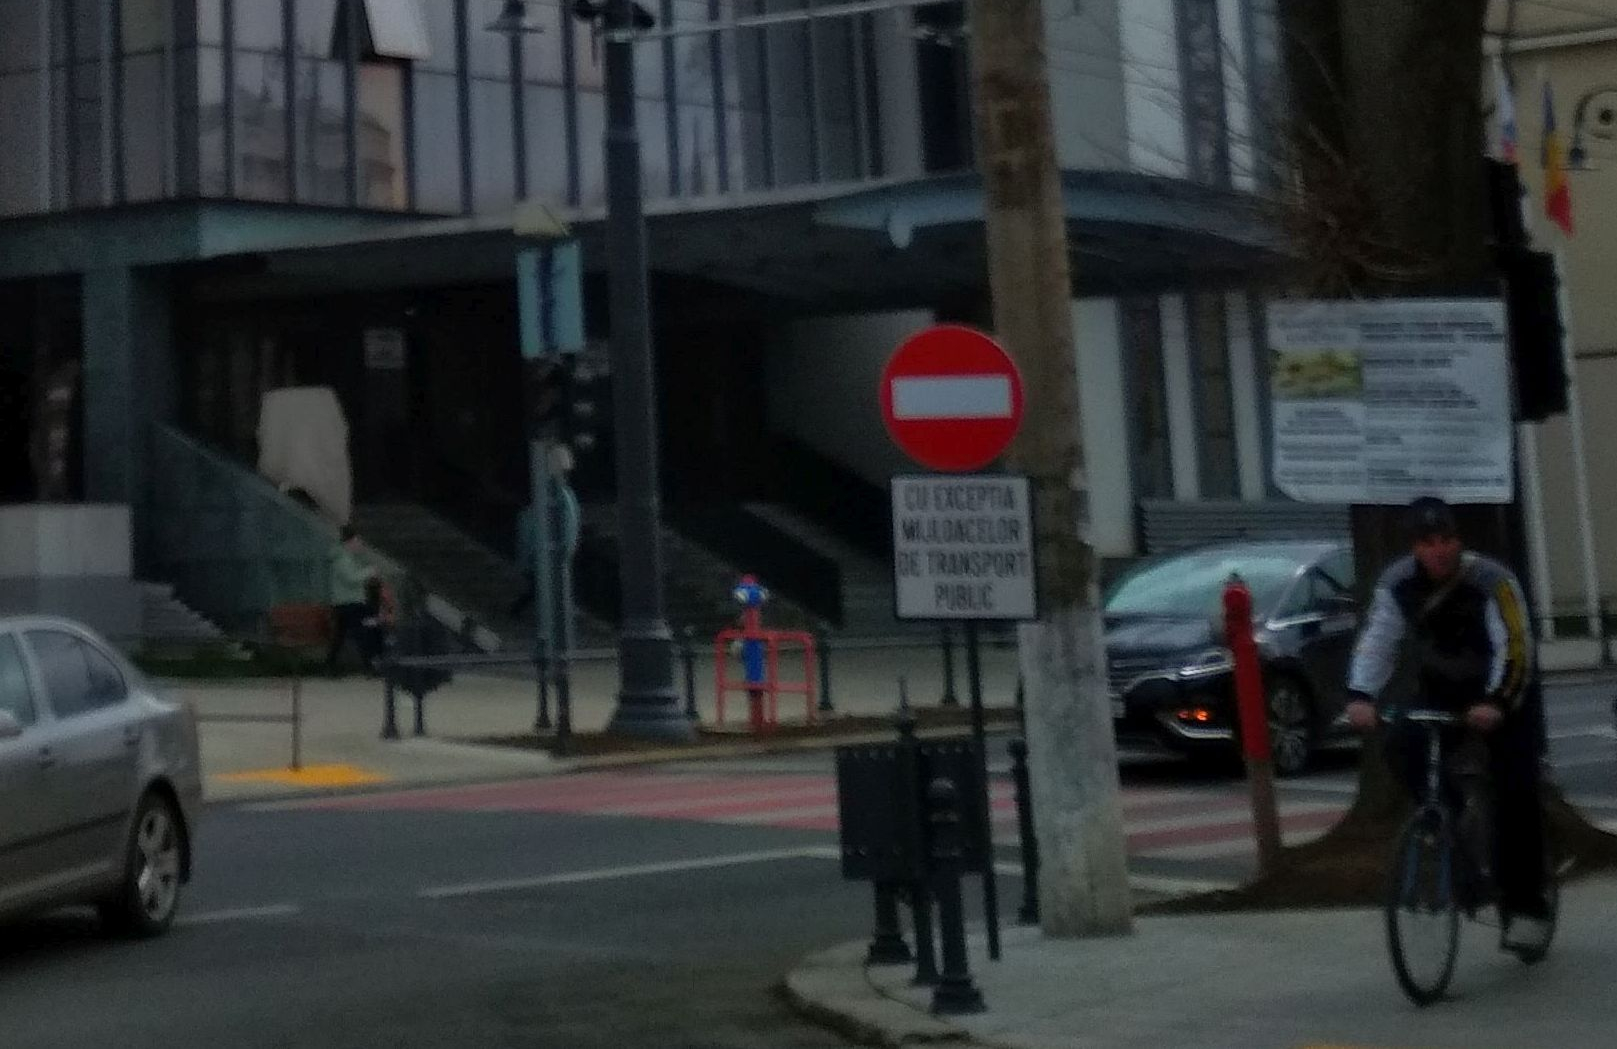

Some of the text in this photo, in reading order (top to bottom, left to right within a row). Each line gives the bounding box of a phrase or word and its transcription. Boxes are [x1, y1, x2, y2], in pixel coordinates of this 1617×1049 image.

[905, 485, 927, 510] CU
[897, 550, 1028, 577] DE TRANSPORT
[935, 584, 993, 610] PUBLIC
